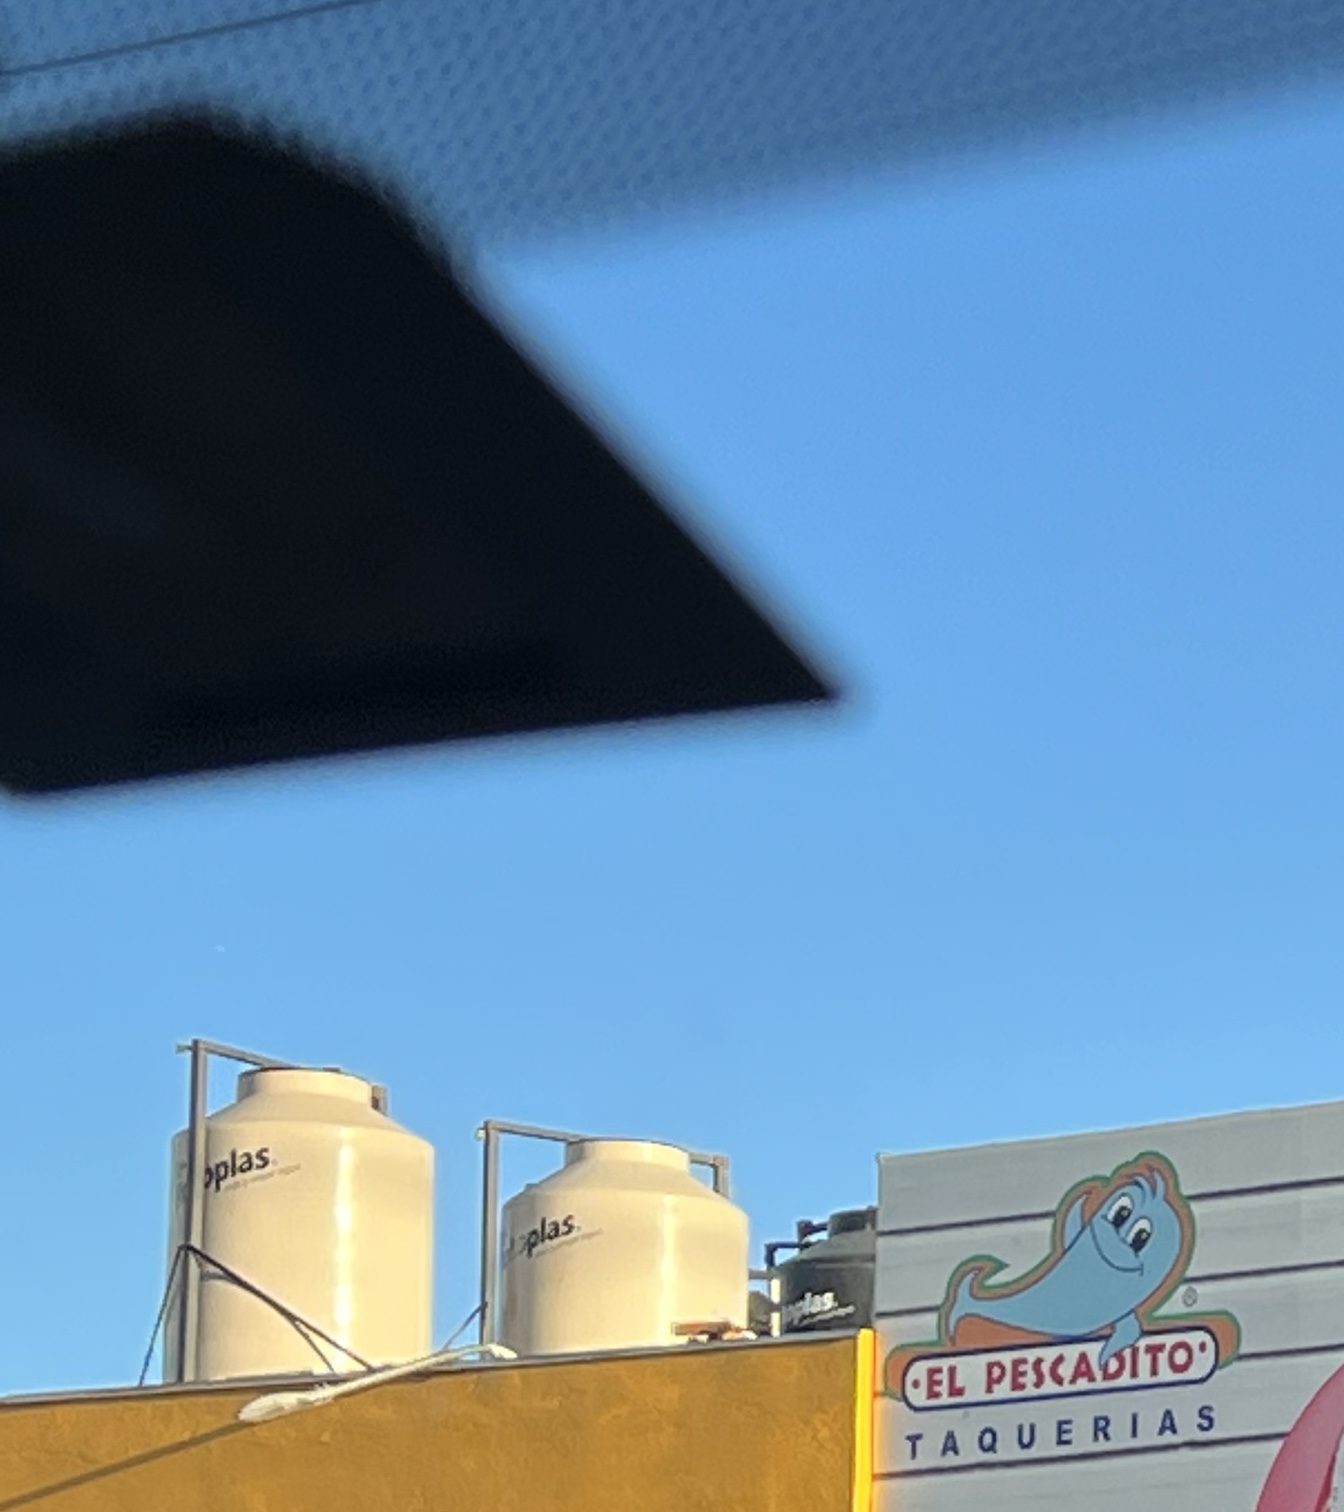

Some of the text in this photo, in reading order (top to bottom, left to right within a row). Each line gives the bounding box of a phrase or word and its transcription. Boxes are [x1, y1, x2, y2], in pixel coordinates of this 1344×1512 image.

[926, 1340, 1195, 1400] EL PESCADITO
[904, 1404, 1216, 1460] TAQUERIAS
